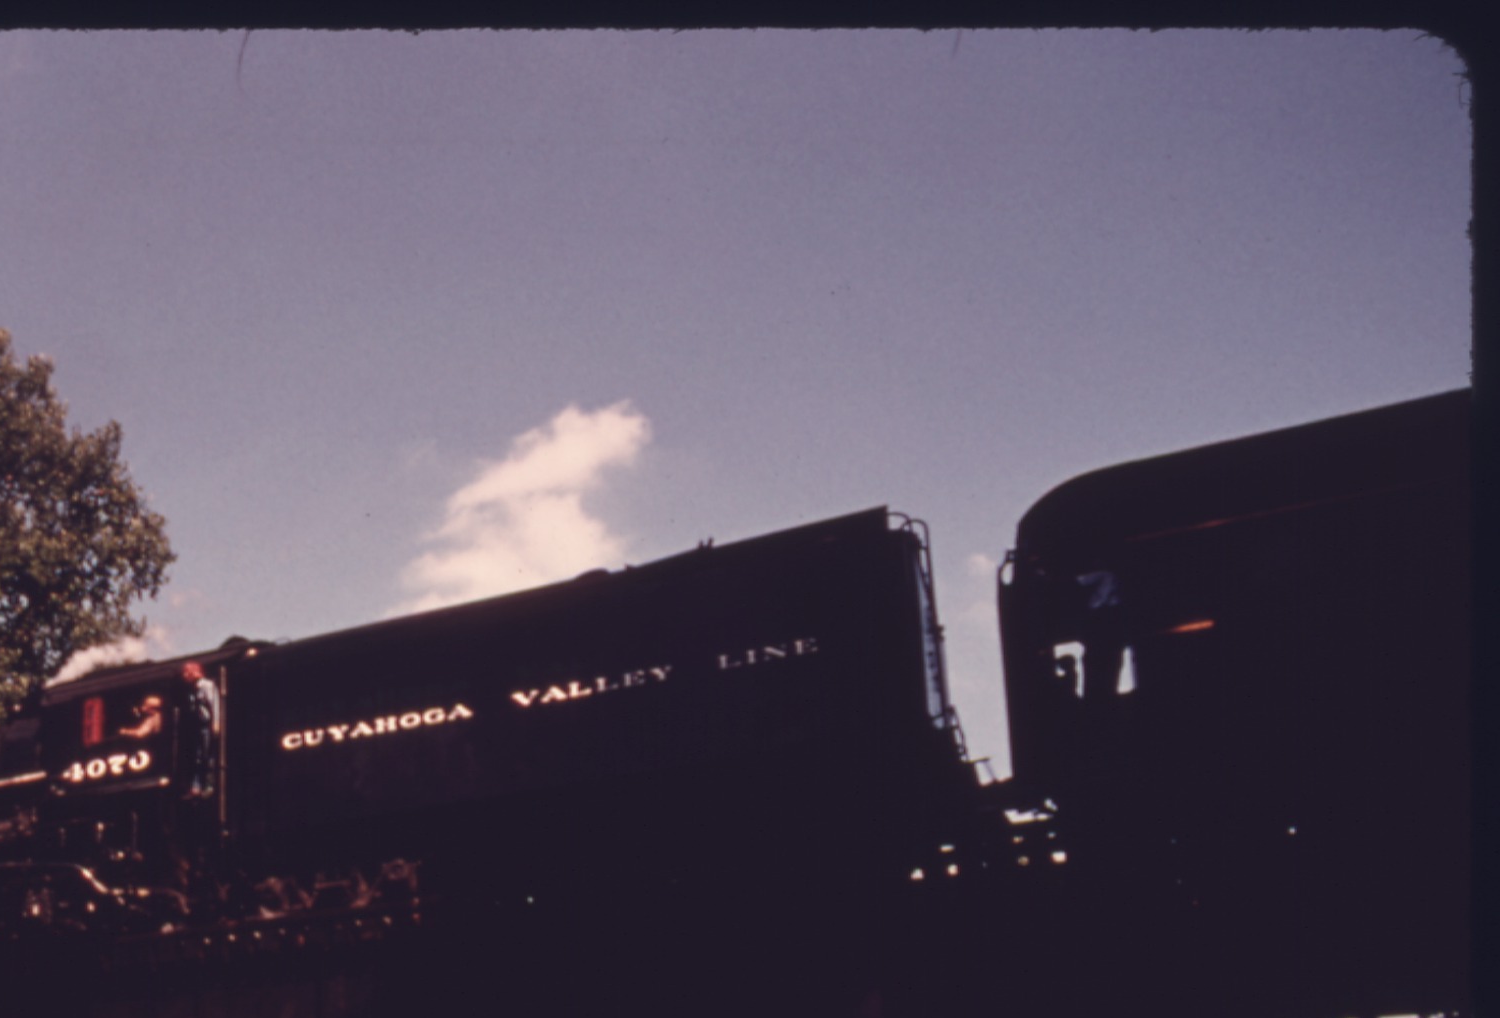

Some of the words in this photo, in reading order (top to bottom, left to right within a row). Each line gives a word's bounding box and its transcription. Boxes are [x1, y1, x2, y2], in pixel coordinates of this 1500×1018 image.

[281, 703, 474, 750] CUYAHOGA
[510, 666, 672, 708] VALLEY
[717, 638, 820, 669] LINE
[61, 750, 151, 783] 4070
